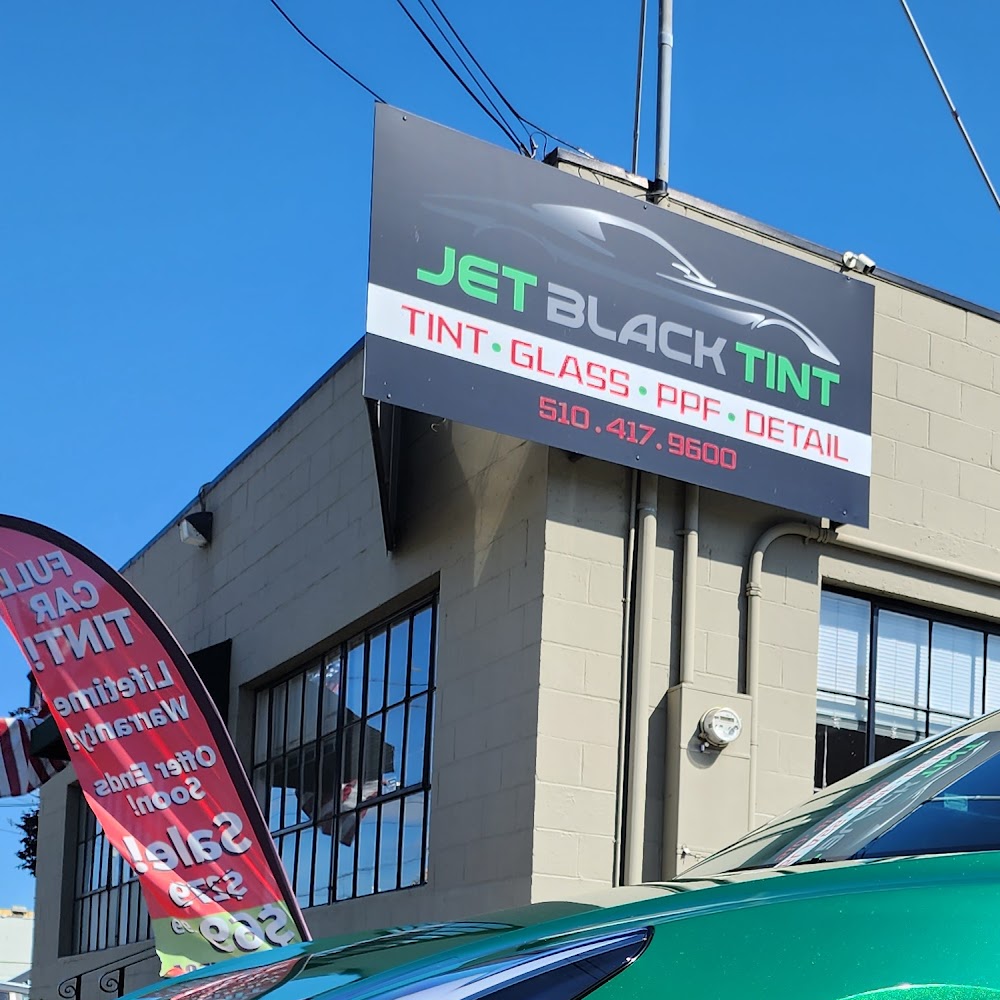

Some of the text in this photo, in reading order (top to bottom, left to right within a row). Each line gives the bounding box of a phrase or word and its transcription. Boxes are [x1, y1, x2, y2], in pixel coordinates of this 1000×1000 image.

[401, 304, 849, 463] TINT GLASS PPF DETAIL
[416, 246, 841, 408] JET BLACK TINT
[538, 395, 738, 471] 510.417.9600
